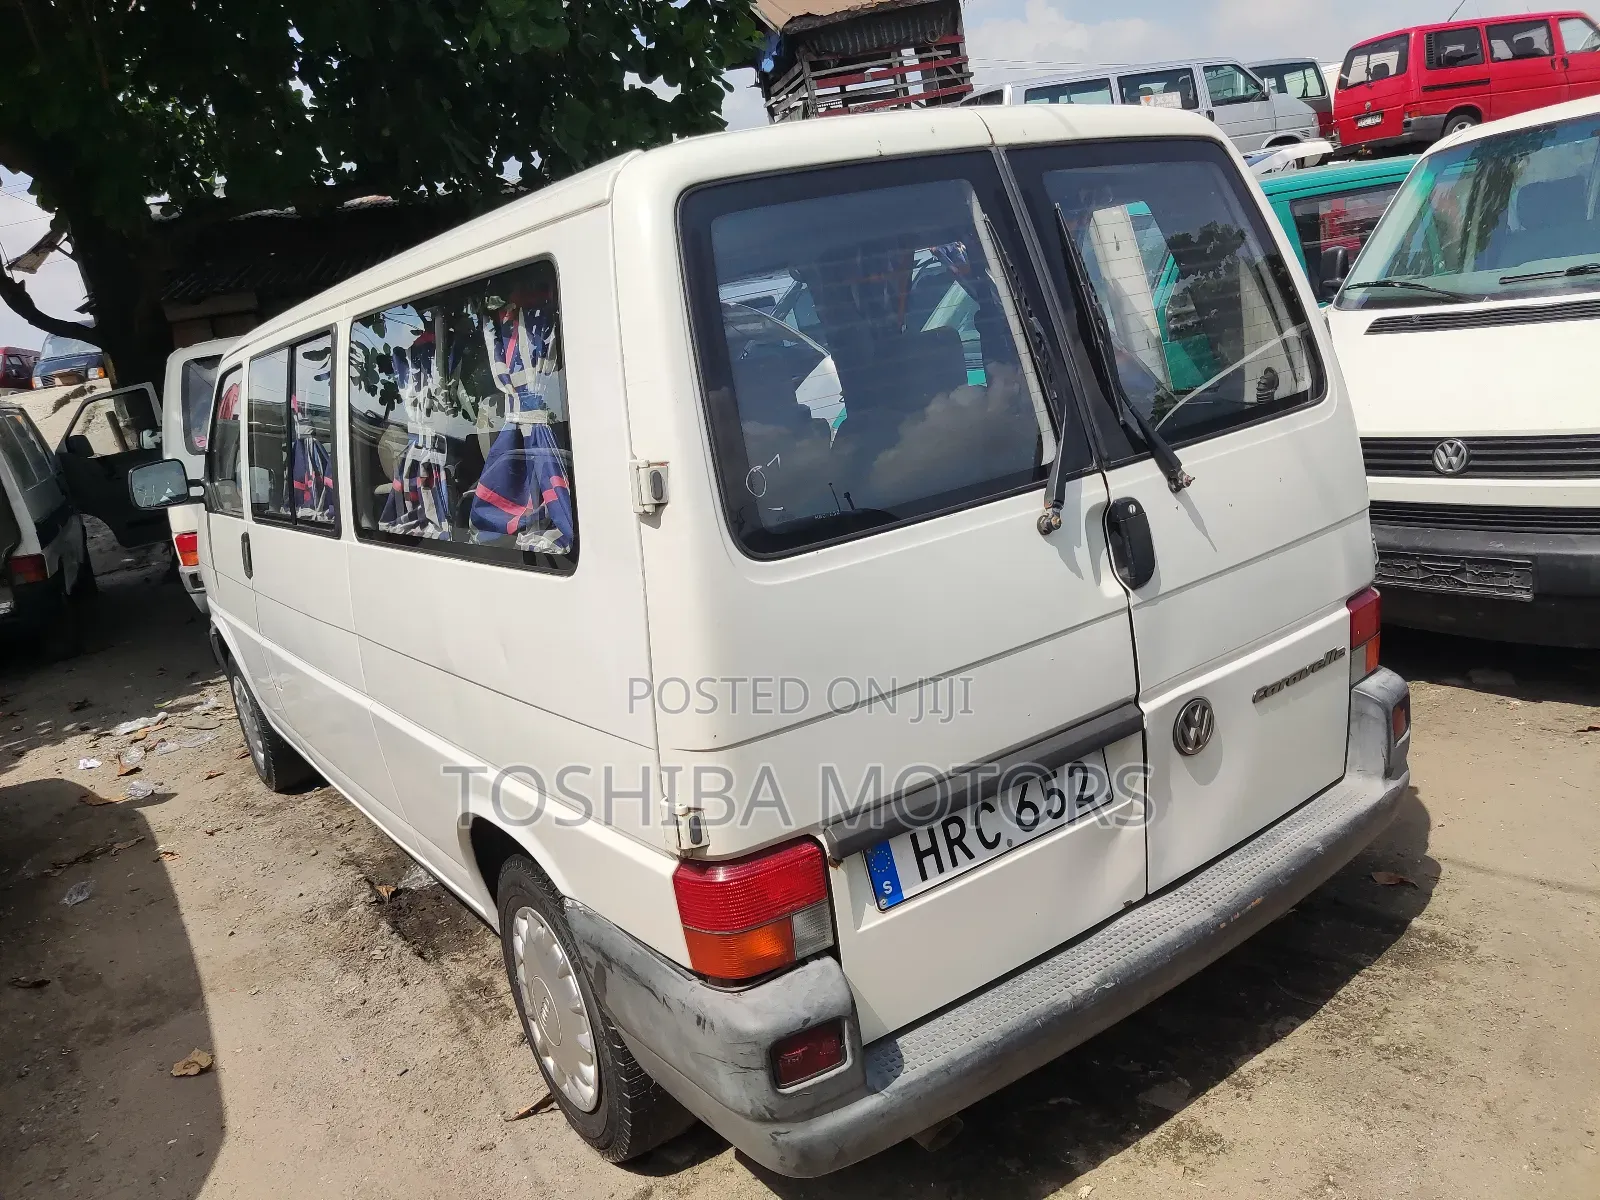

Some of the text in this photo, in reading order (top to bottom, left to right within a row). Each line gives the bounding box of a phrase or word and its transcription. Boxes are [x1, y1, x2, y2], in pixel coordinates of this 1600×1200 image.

[1252, 646, 1345, 703] Caravelle
[909, 761, 1095, 881] HRC 652
[882, 880, 893, 895] S
